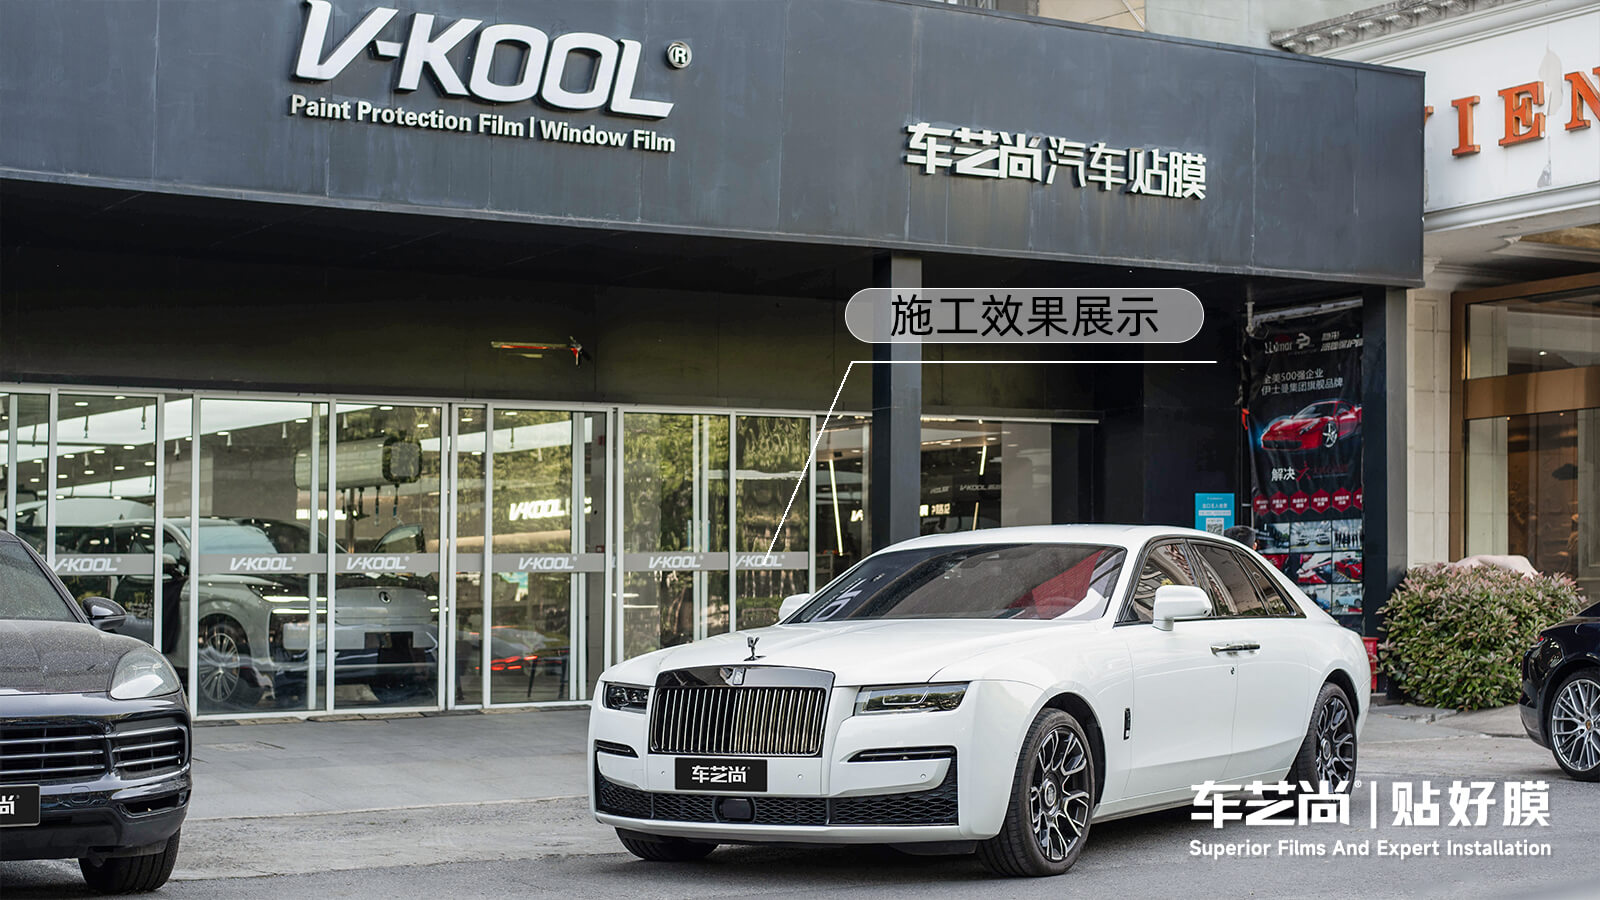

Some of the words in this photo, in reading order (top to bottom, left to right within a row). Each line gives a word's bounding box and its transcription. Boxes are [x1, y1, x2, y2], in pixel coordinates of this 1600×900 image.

[291, 93, 351, 120] Paint
[357, 100, 472, 132] Protection
[478, 113, 524, 137] Film
[540, 119, 627, 147] Window
[632, 129, 676, 152] Film
[230, 556, 293, 571] V-KOOL
[346, 556, 406, 570] V-KOOL
[518, 556, 575, 570] V-KOOL
[649, 555, 700, 569] V-KOOL
[691, 765, 747, 783] 车艺尚
